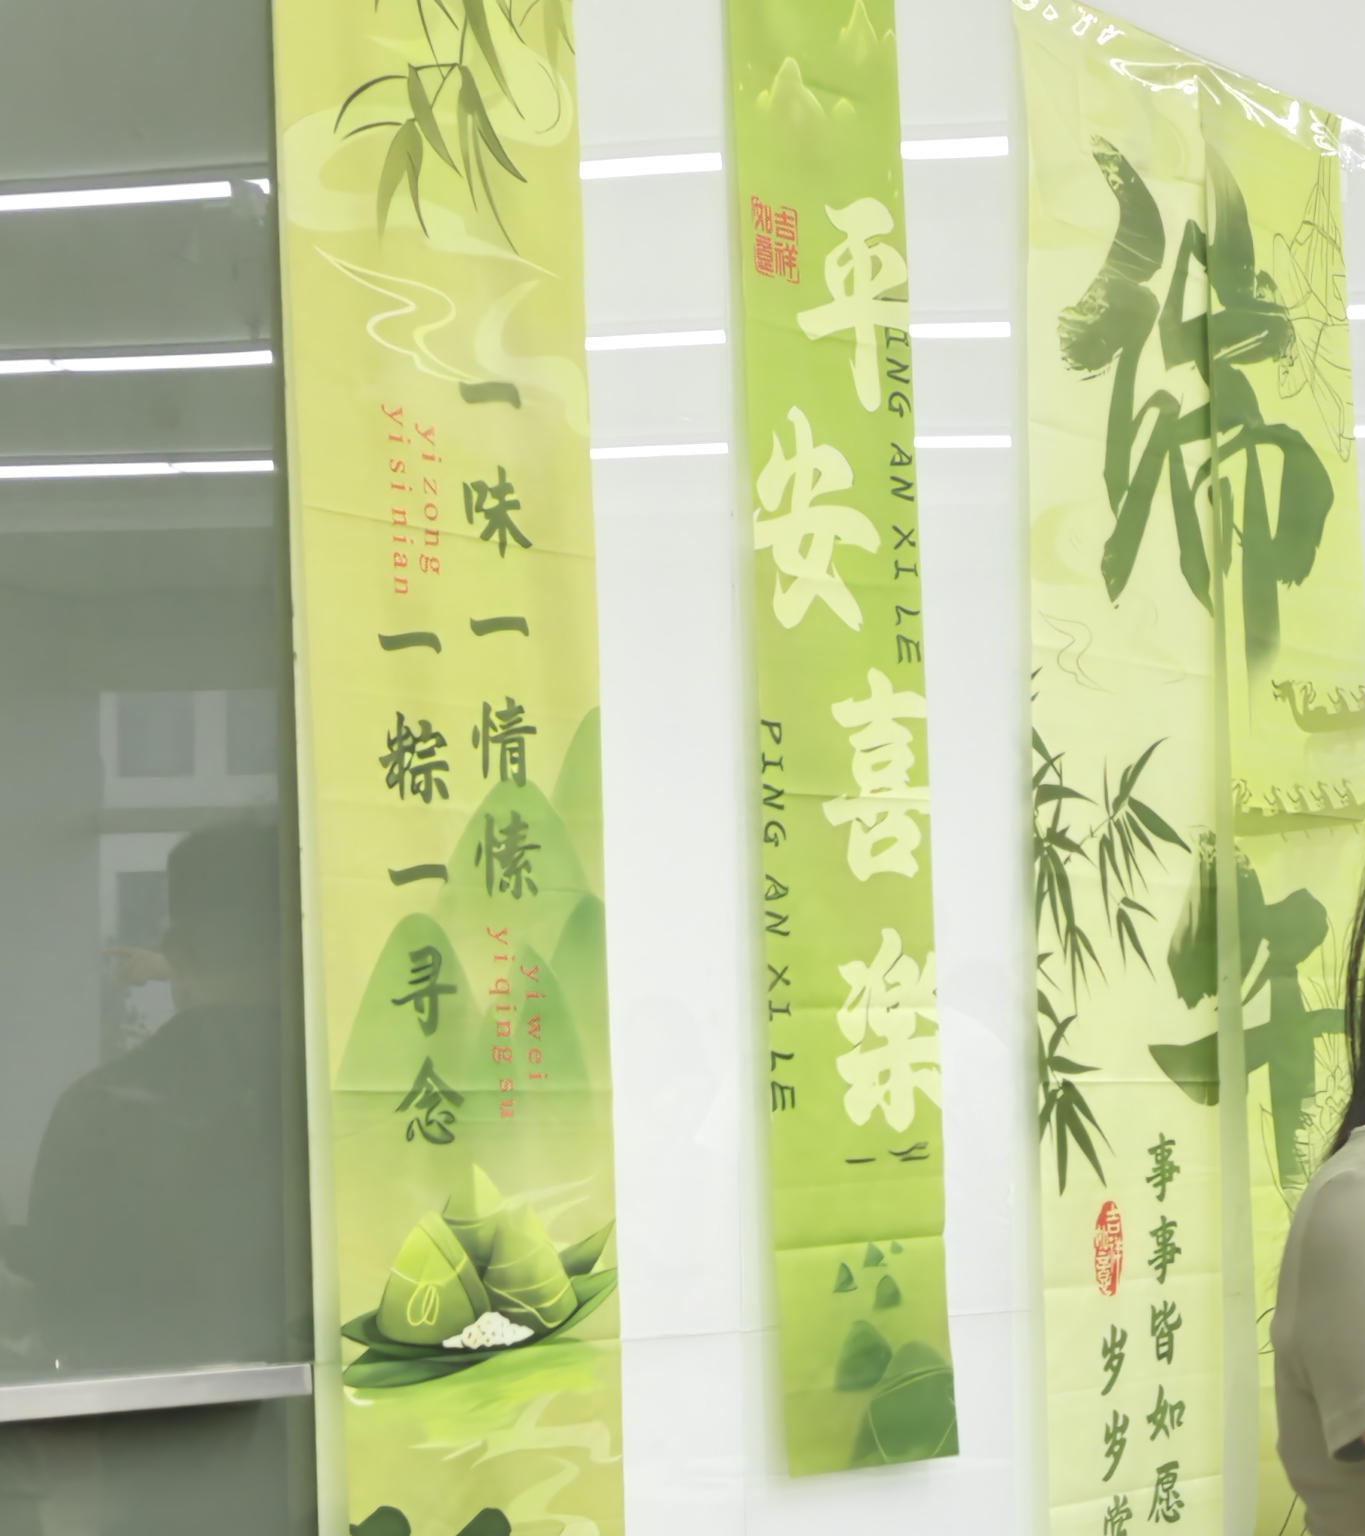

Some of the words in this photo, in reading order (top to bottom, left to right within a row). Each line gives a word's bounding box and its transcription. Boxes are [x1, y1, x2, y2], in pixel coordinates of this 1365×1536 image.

[884, 297, 914, 420] ING
[889, 442, 915, 502] AN
[893, 525, 919, 580] XI
[896, 604, 922, 665] LE
[760, 718, 788, 849] PING
[764, 874, 790, 937] AN
[768, 963, 792, 1022] XI
[770, 1050, 796, 1113] LE
[1145, 1132, 1186, 1525] 事事皆如愿
